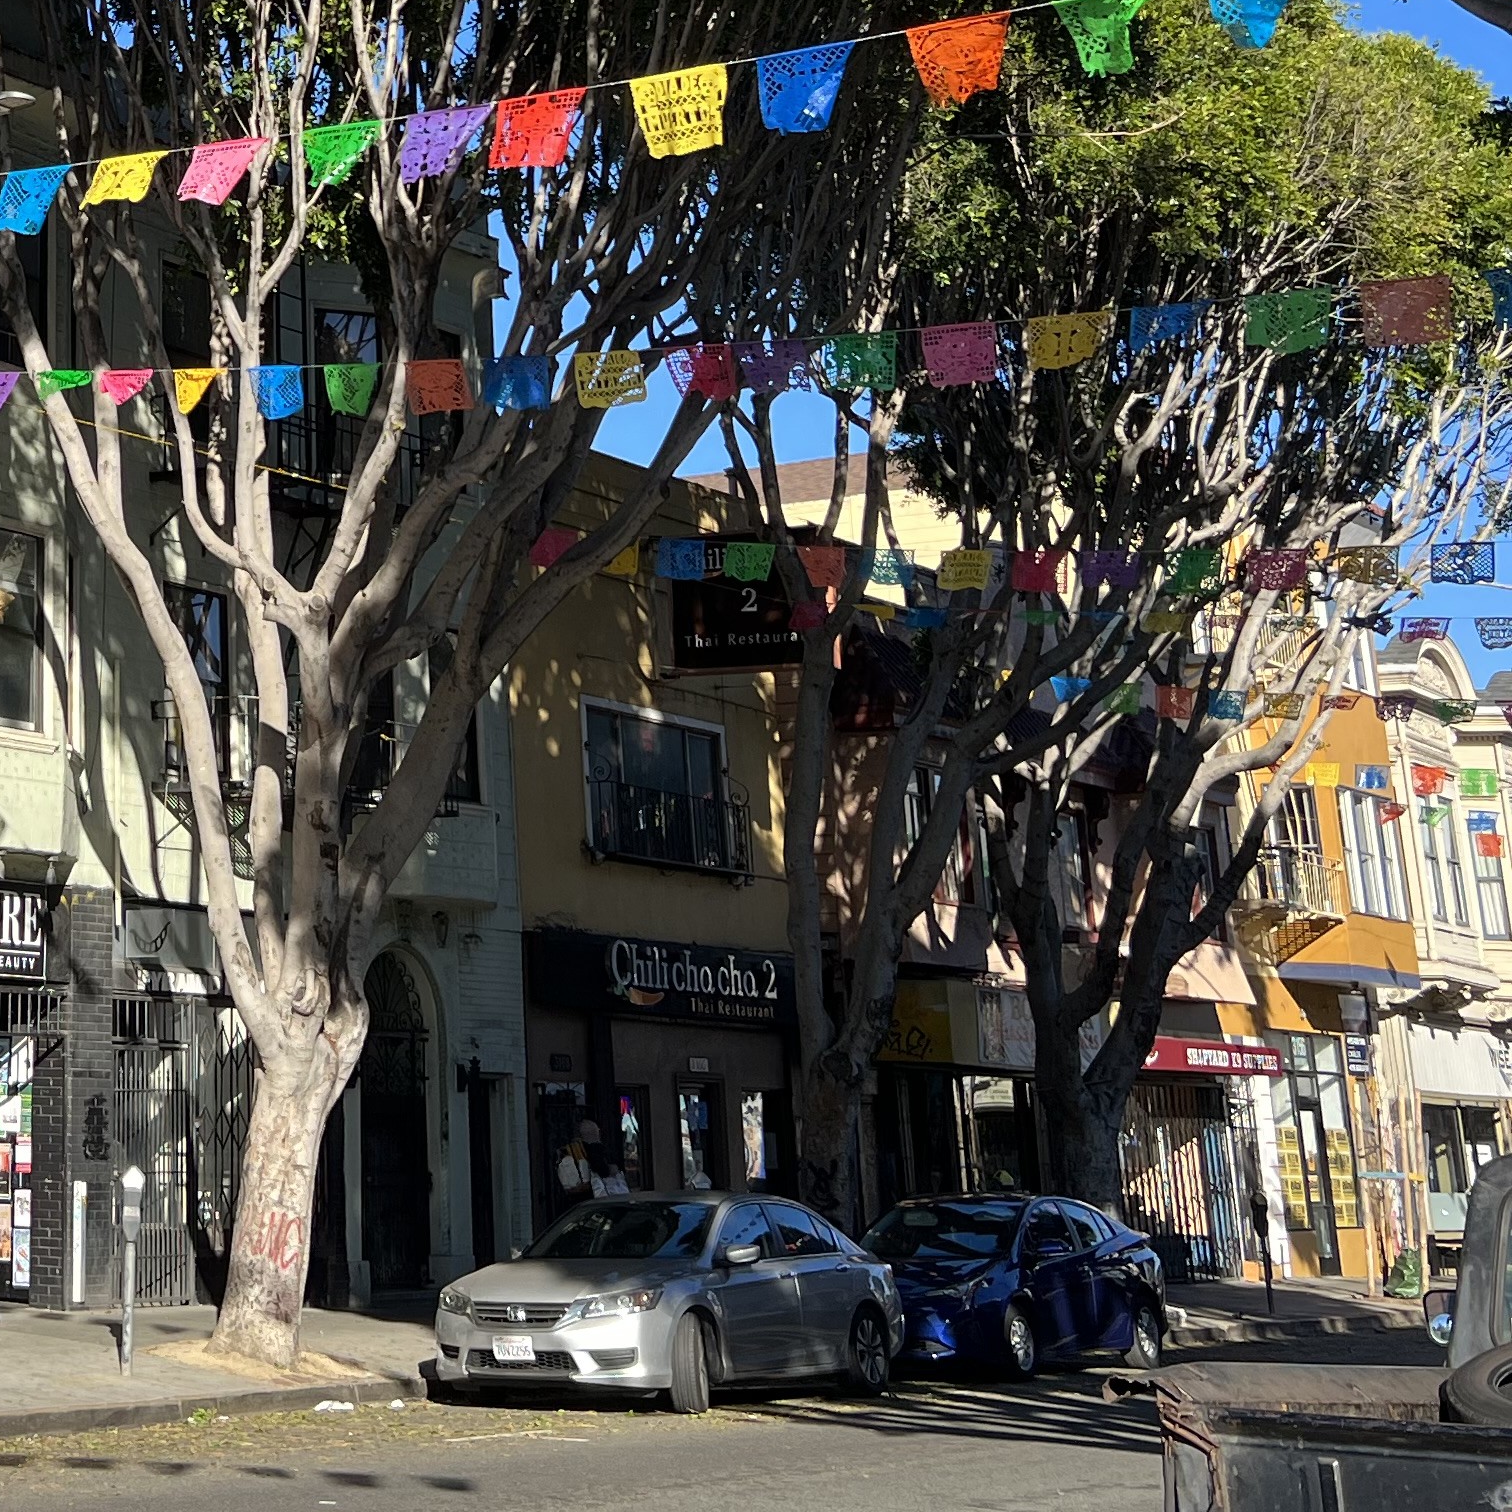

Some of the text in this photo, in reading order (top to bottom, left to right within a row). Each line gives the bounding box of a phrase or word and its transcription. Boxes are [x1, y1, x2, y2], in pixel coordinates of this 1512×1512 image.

[740, 587, 758, 612] 2
[683, 631, 798, 648] Thai Restaura
[611, 939, 669, 989] Chili
[762, 959, 778, 999] 2
[690, 997, 775, 1019] Thai Restaurant
